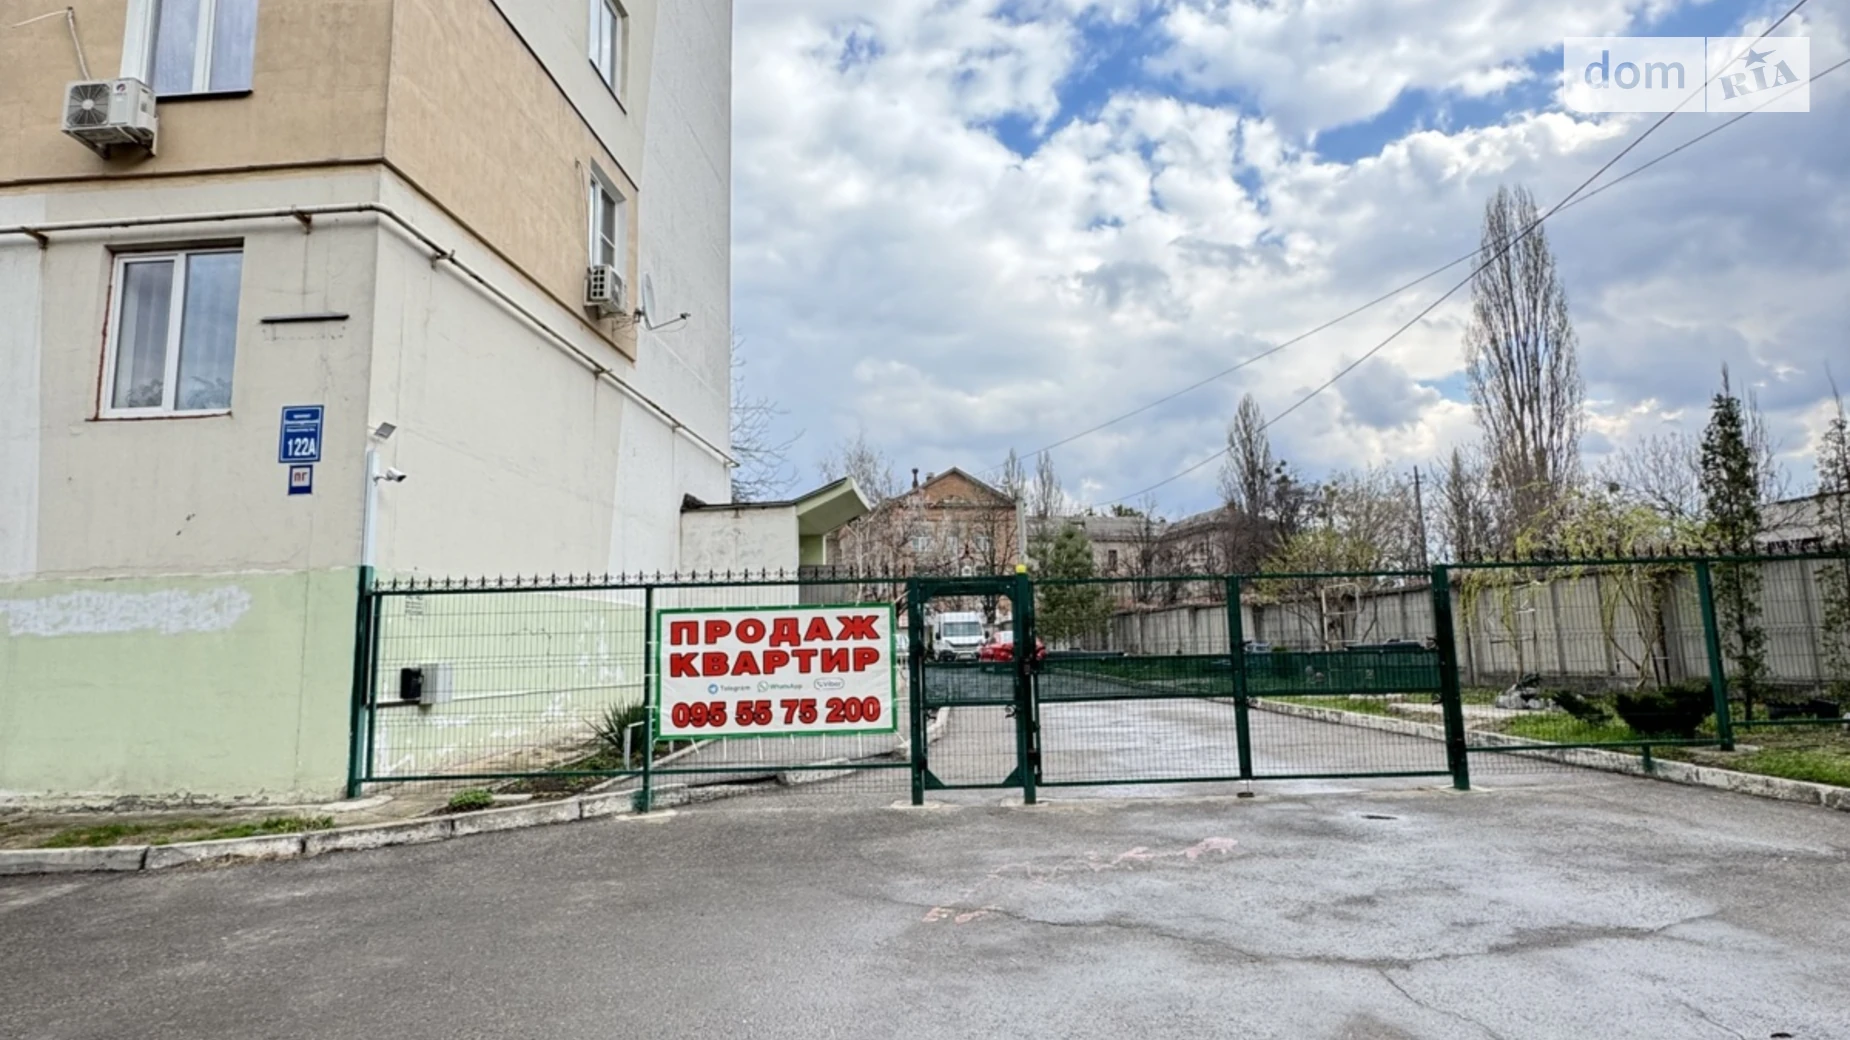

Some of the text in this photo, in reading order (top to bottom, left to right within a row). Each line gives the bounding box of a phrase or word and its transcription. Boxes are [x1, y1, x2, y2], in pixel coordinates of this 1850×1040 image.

[287, 437, 316, 457] 122А
[670, 615, 881, 647] ПРОДАЖ
[670, 647, 880, 678] КВАРТИР
[720, 680, 842, 695] Telegram WhatsApp Viber
[671, 695, 881, 728] 095 55 75 200
